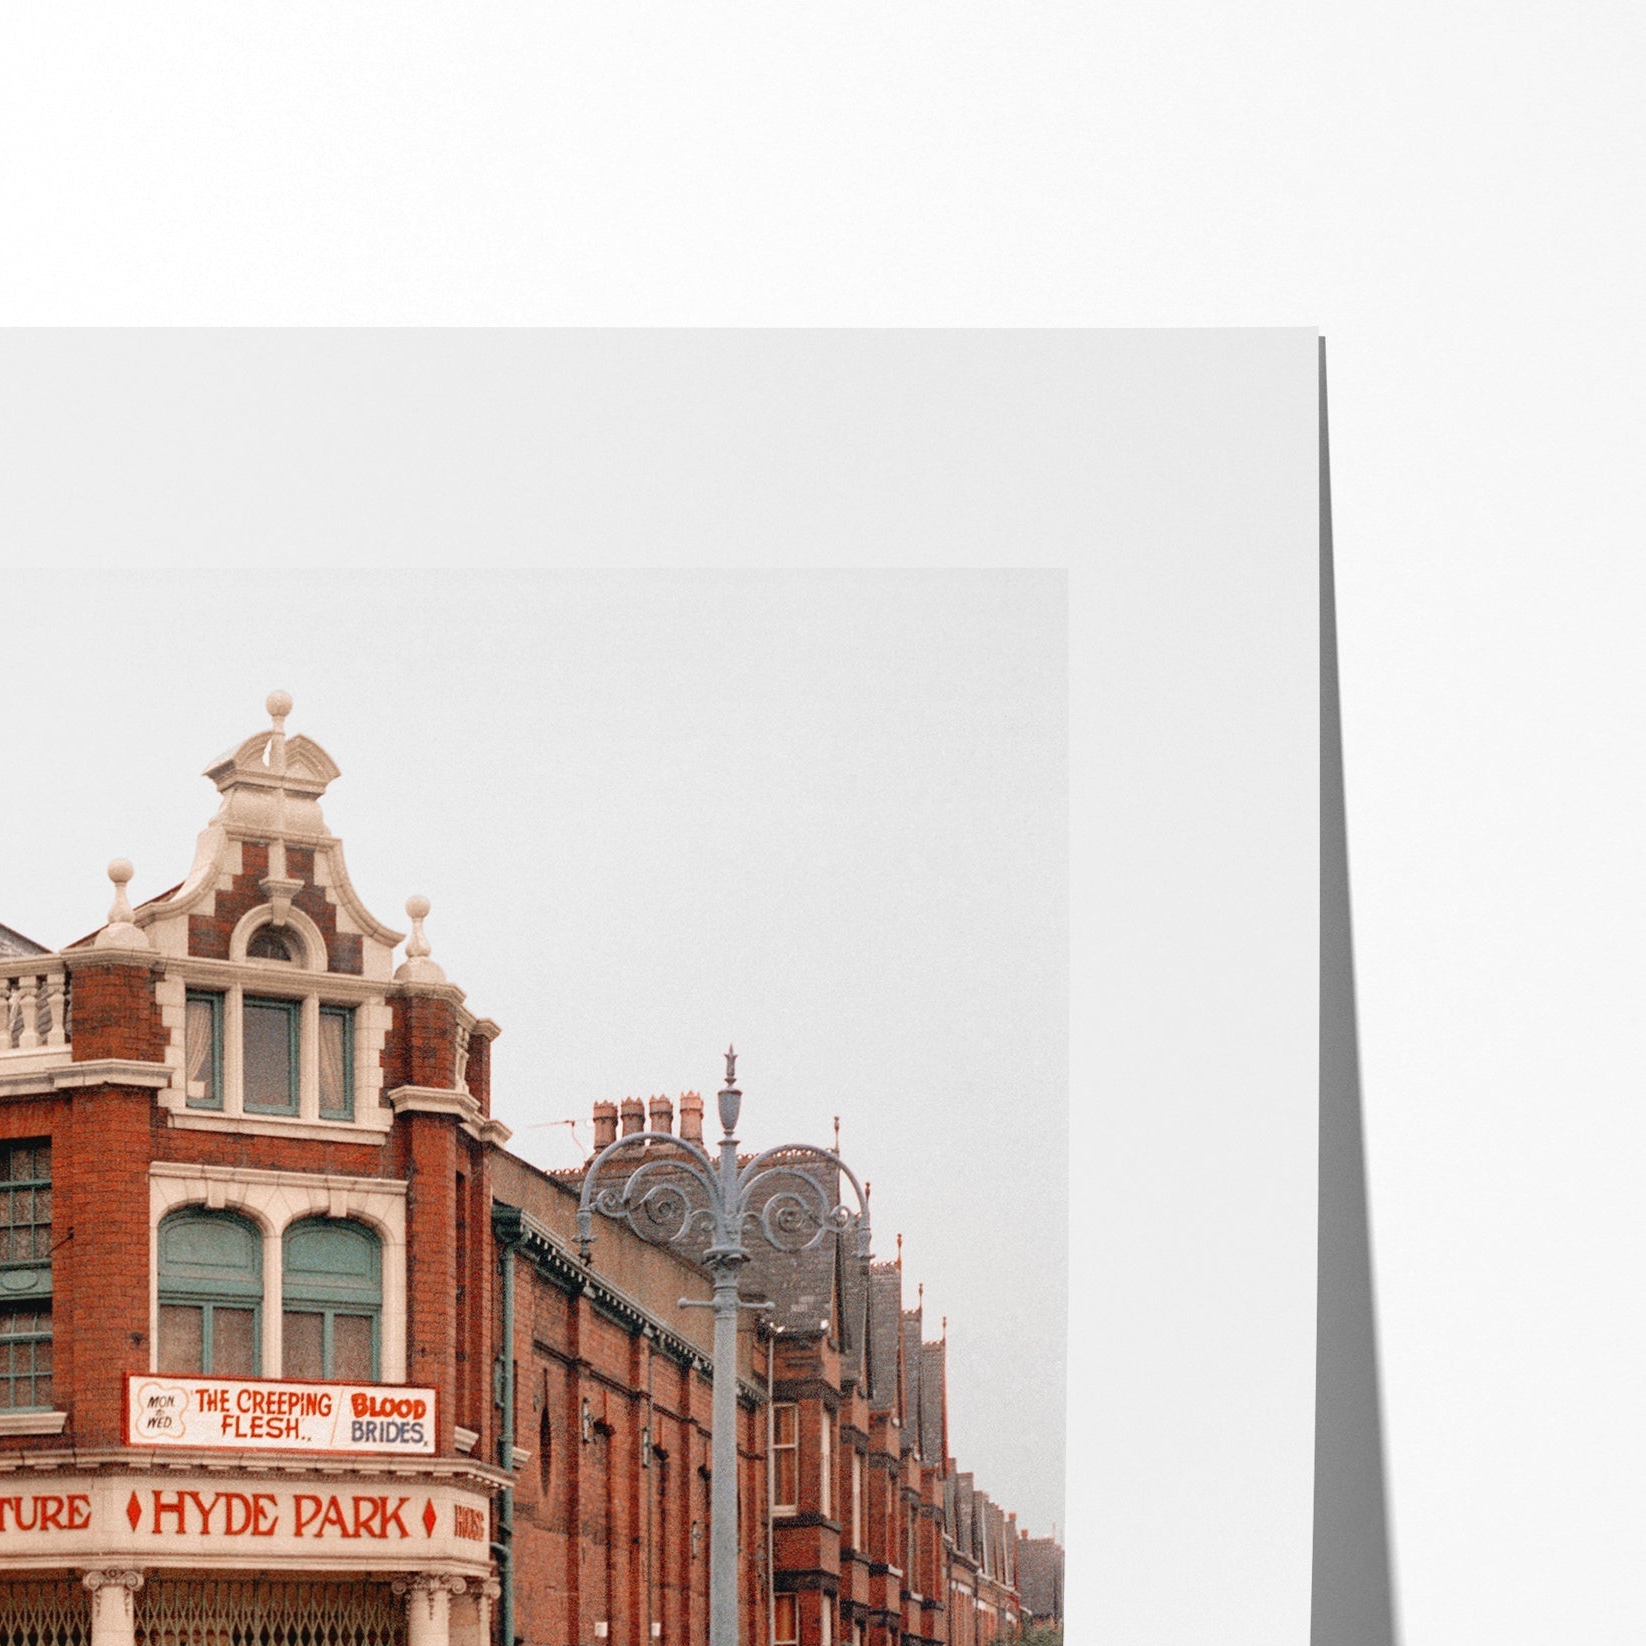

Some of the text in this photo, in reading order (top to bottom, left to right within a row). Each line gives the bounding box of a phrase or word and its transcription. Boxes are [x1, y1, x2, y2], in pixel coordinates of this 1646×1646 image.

[236, 1389, 332, 1417] CREEPING
[351, 1392, 426, 1420] BLOOD
[153, 1490, 410, 1539] HYDE PARK
